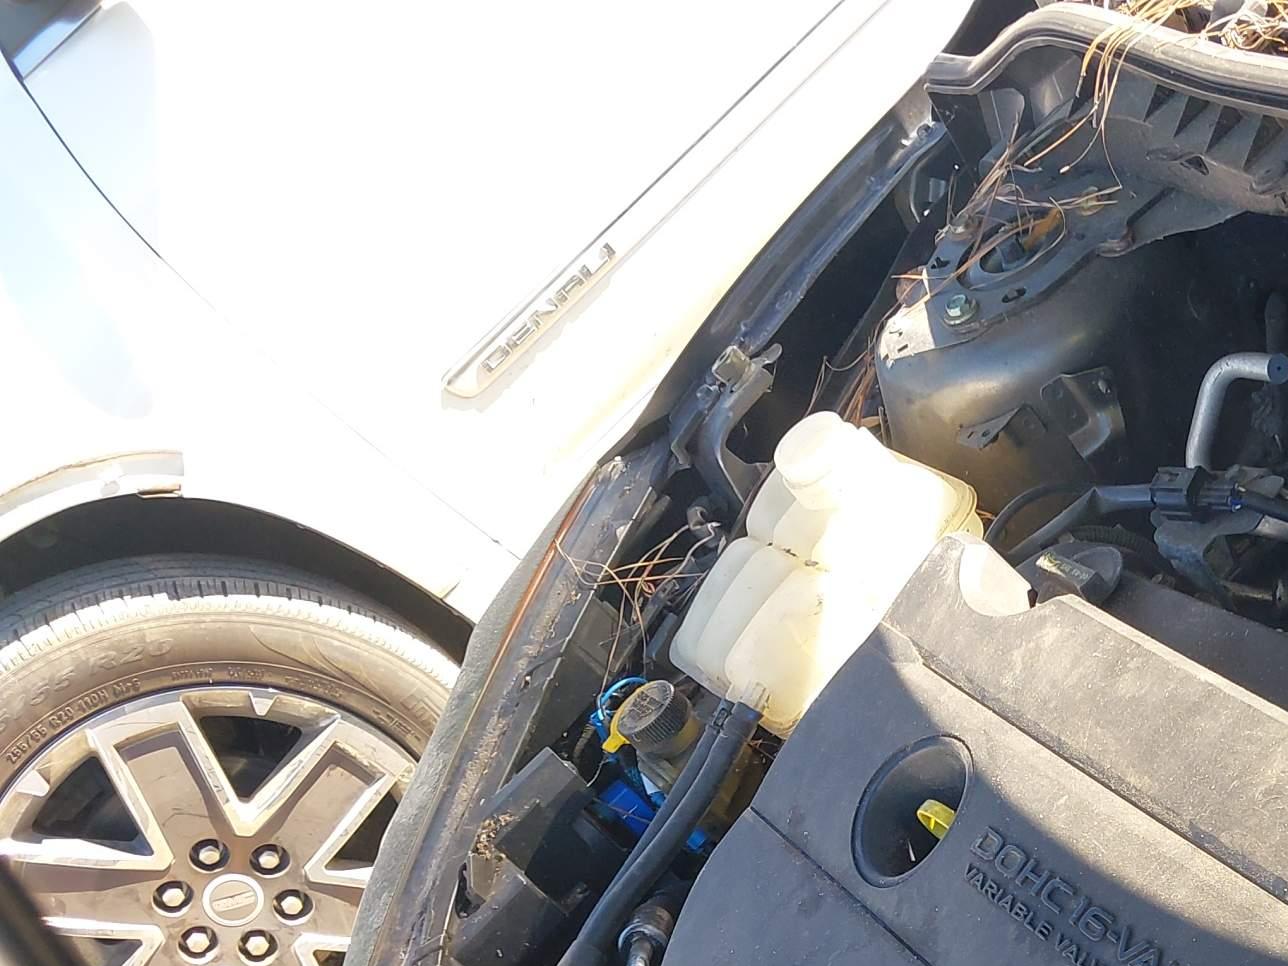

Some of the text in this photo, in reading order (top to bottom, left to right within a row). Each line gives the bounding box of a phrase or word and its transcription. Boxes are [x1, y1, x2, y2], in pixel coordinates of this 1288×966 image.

[481, 242, 616, 373] DENALI
[50, 705, 75, 728] R20
[78, 688, 110, 715] 110H
[964, 862, 1053, 942] VARIABLE
[970, 825, 1075, 915] DOHC
